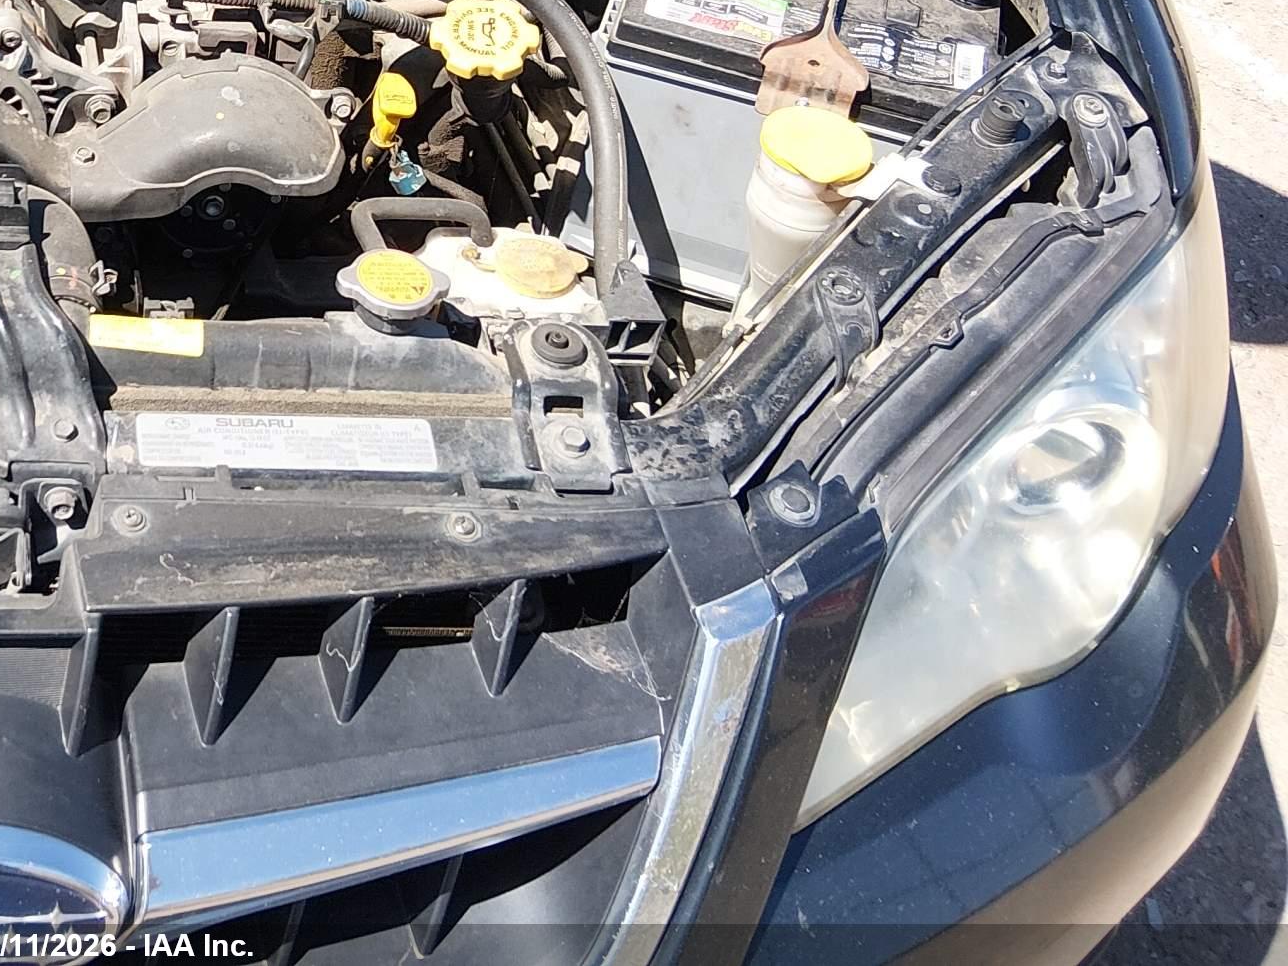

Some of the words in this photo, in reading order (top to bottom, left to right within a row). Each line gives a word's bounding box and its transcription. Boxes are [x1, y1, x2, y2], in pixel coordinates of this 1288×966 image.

[499, 12, 519, 39] ENGINE
[459, 40, 497, 56] MANUAL
[499, 40, 515, 51] OIL
[215, 417, 294, 429] SUBARU
